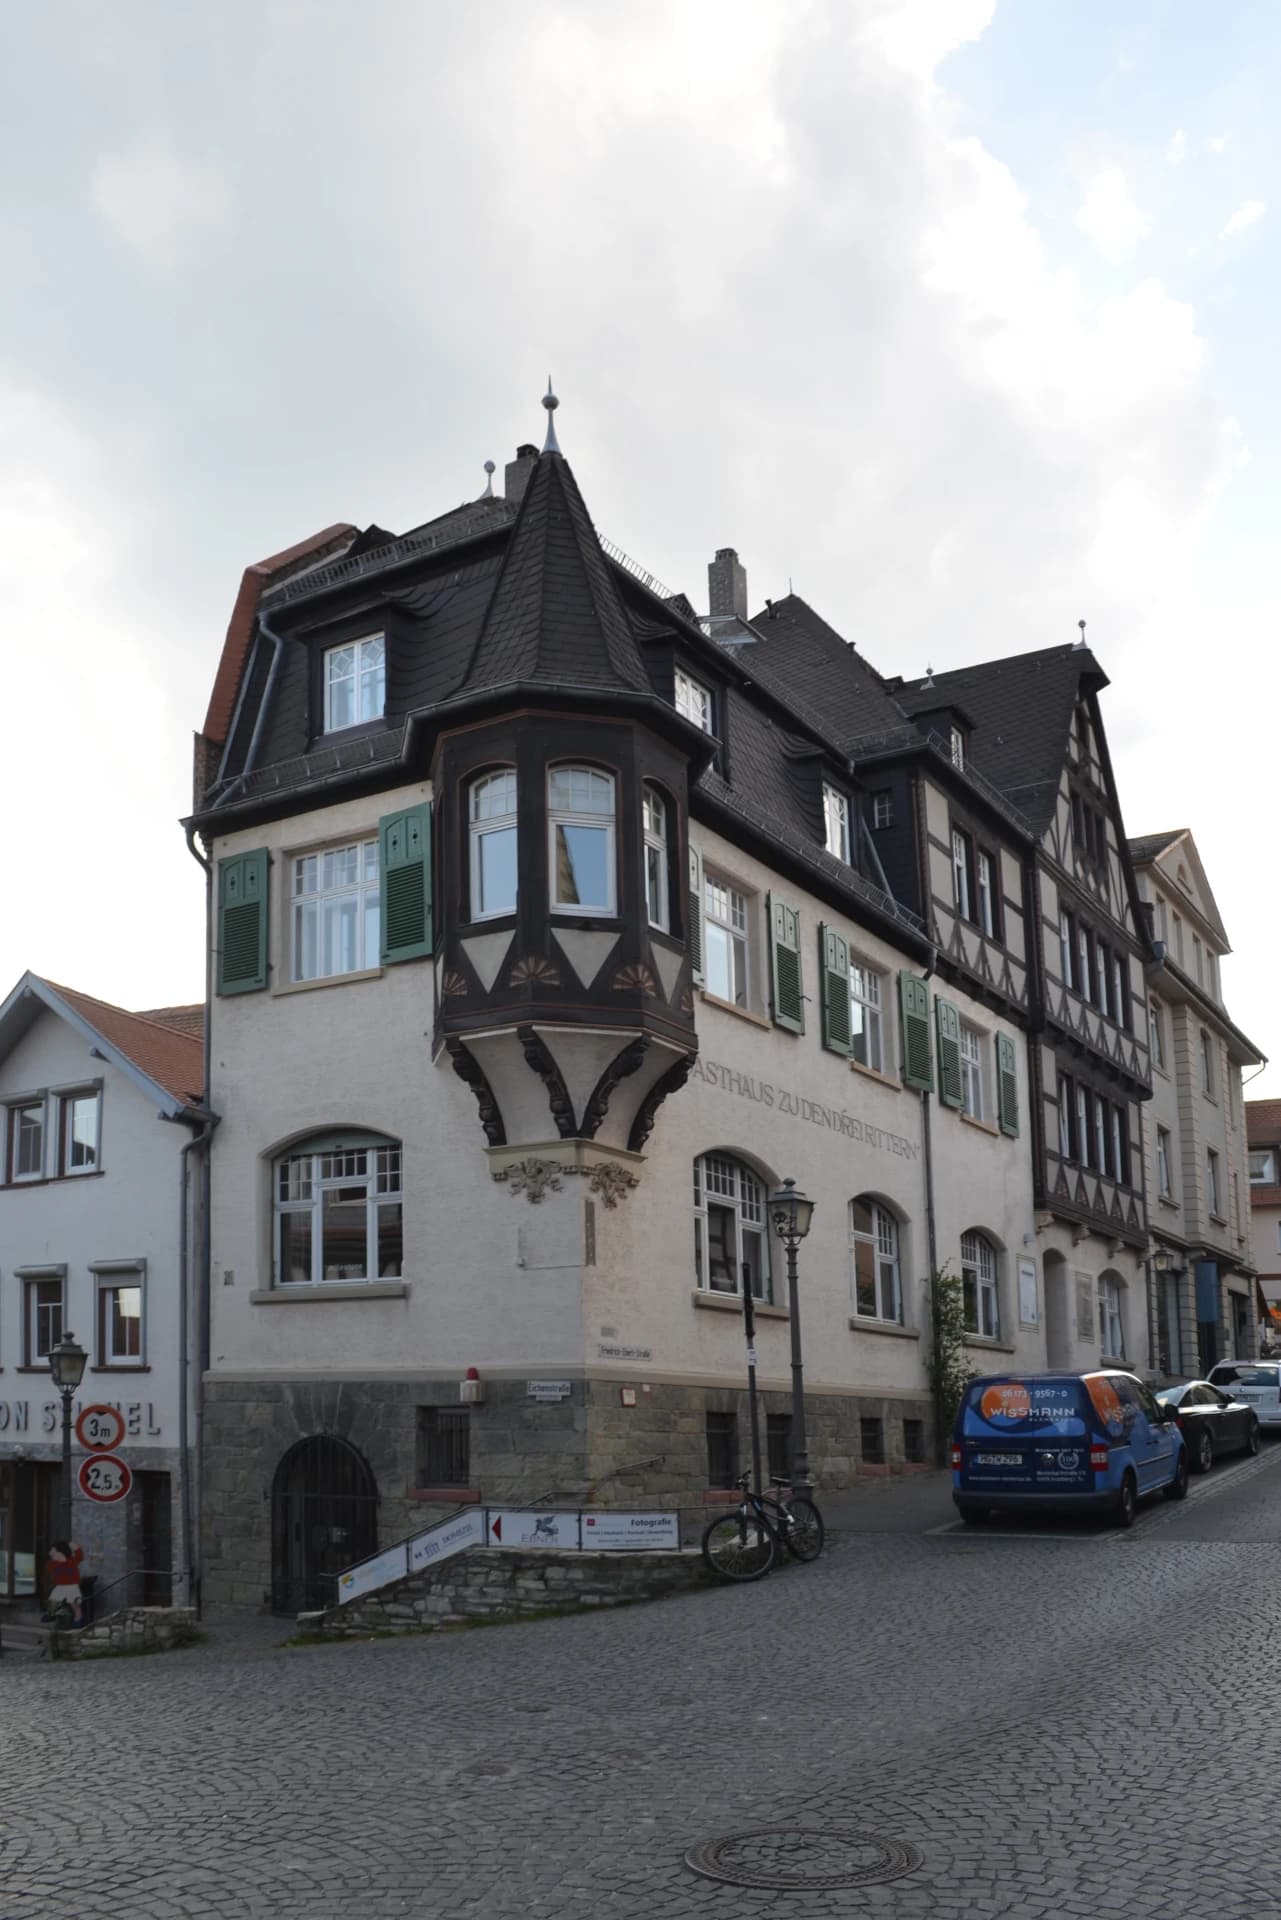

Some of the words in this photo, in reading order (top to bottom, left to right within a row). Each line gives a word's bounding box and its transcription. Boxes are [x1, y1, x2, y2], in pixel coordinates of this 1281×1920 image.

[689, 1056, 774, 1106] ASTHAUS
[778, 1090, 799, 1115] ZU
[801, 1099, 831, 1128] DEN
[90, 1419, 98, 1437] 3
[100, 1427, 110, 1437] m
[631, 1517, 672, 1527] Fotografie
